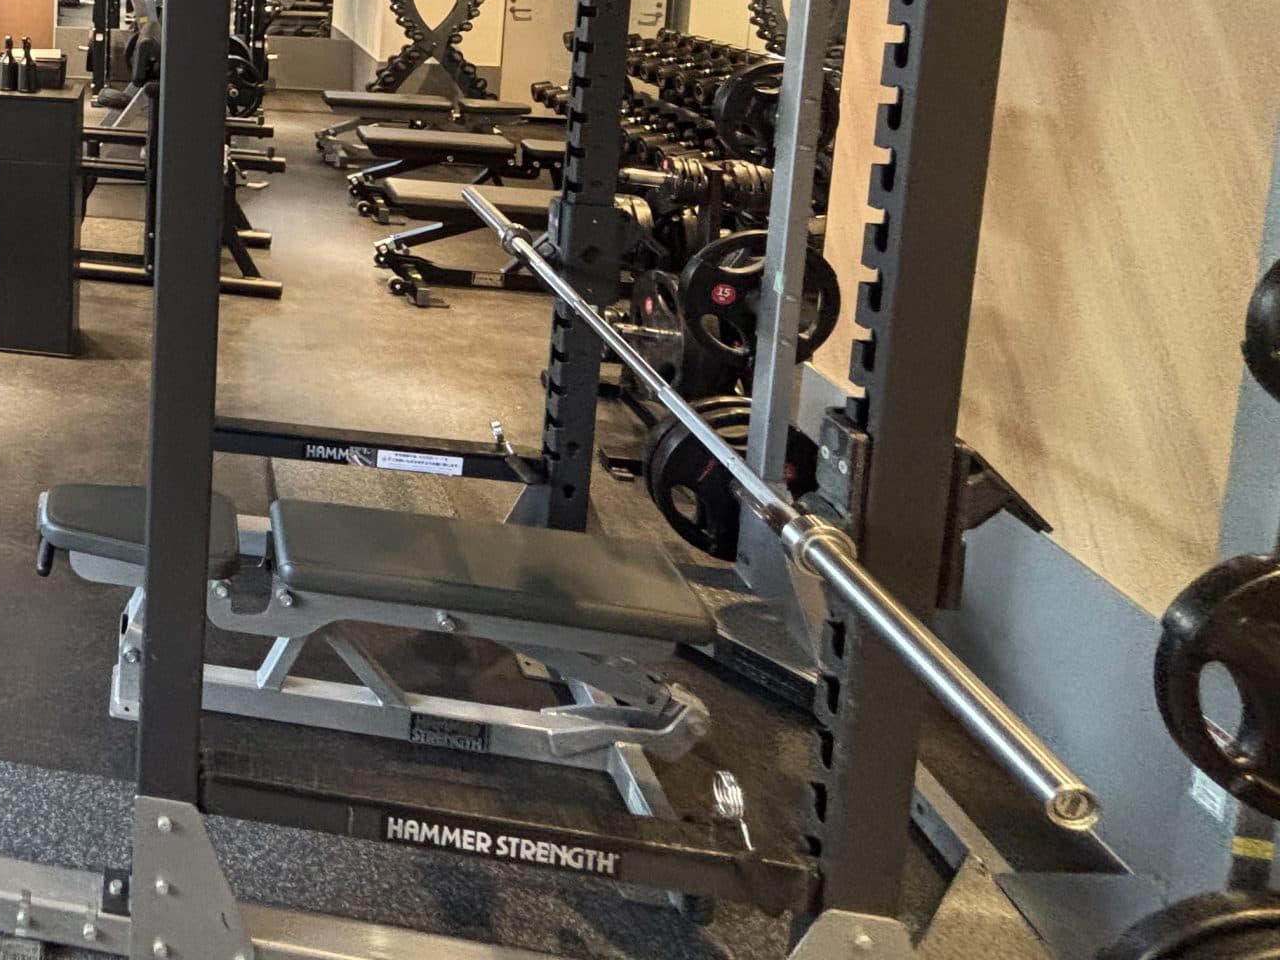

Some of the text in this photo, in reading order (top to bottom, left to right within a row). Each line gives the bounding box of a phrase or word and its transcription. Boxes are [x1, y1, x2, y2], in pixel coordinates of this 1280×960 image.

[306, 444, 354, 461] HAMM
[387, 816, 615, 874] HAMMER STRENGTH
